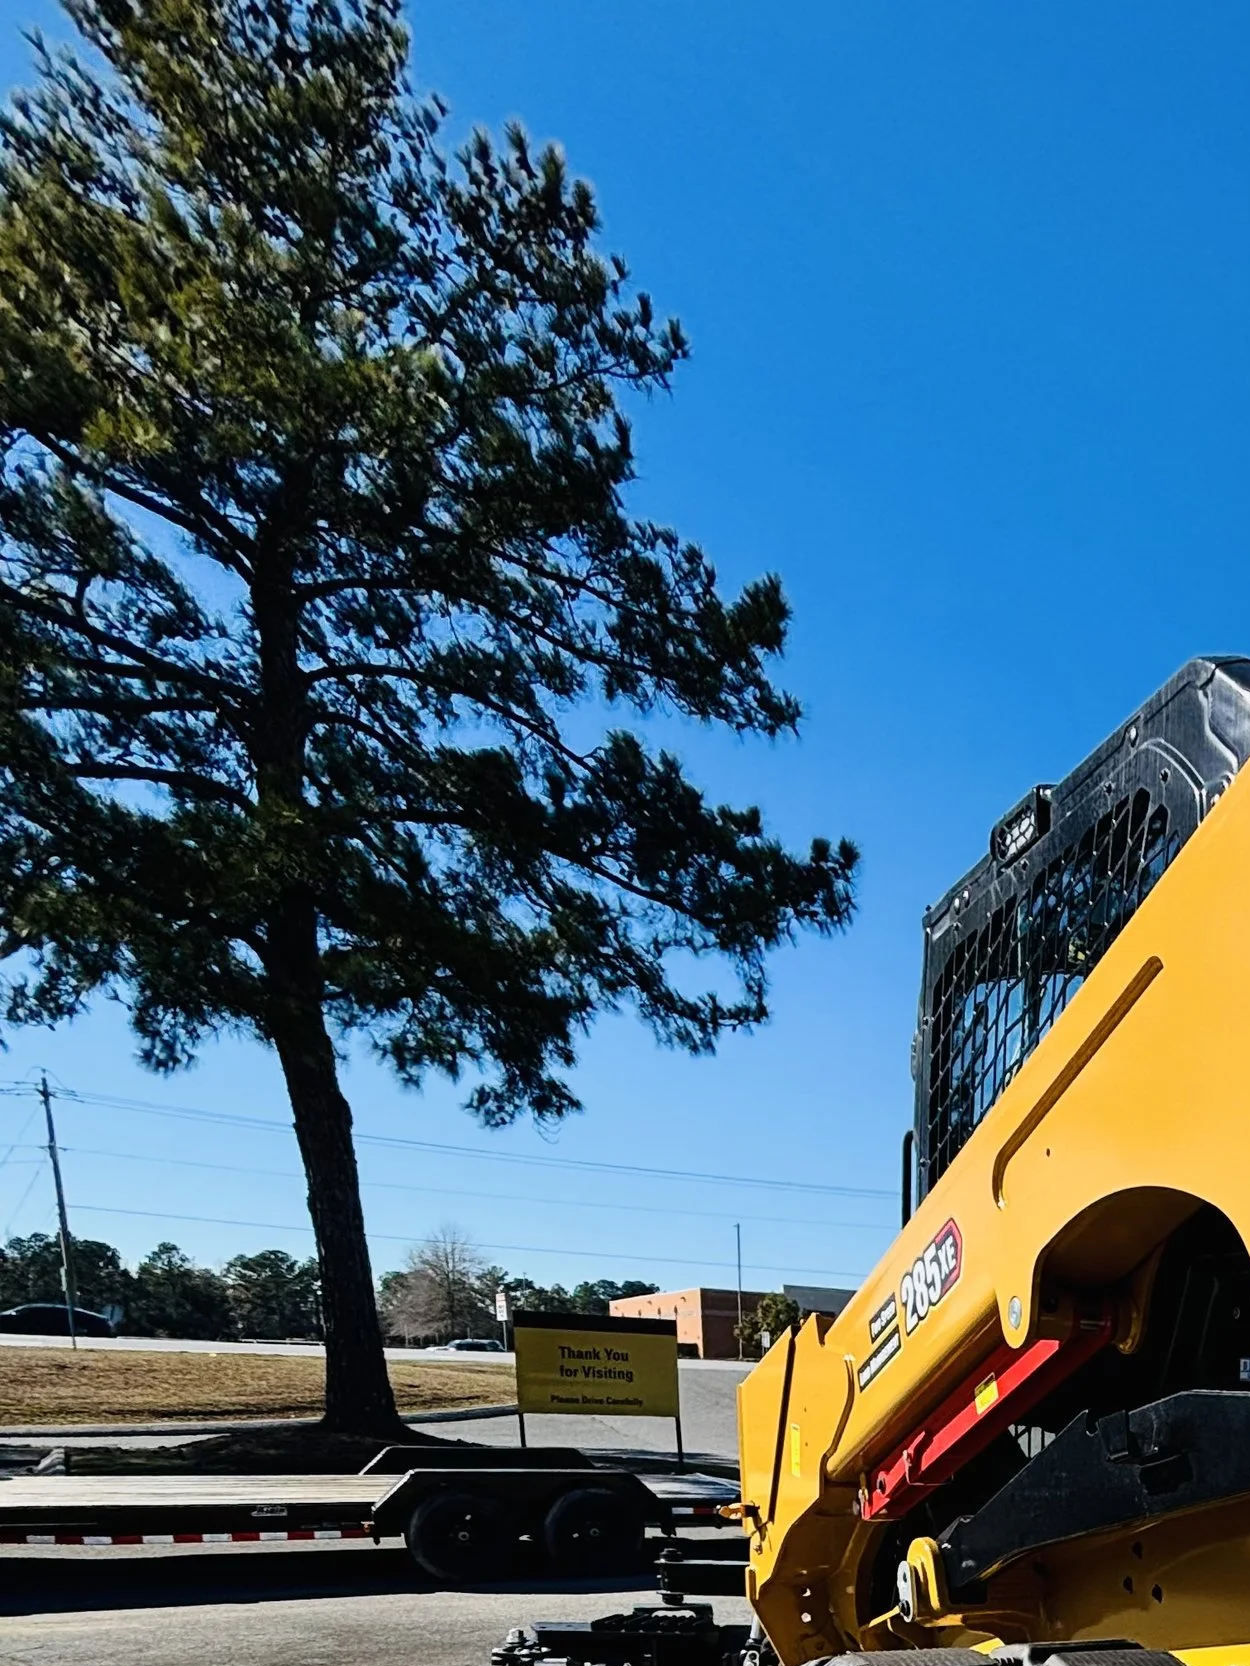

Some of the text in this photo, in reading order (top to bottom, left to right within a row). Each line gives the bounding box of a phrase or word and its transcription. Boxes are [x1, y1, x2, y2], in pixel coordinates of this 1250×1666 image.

[558, 1346, 629, 1361] Thank You
[560, 1365, 634, 1383] for Visiting
